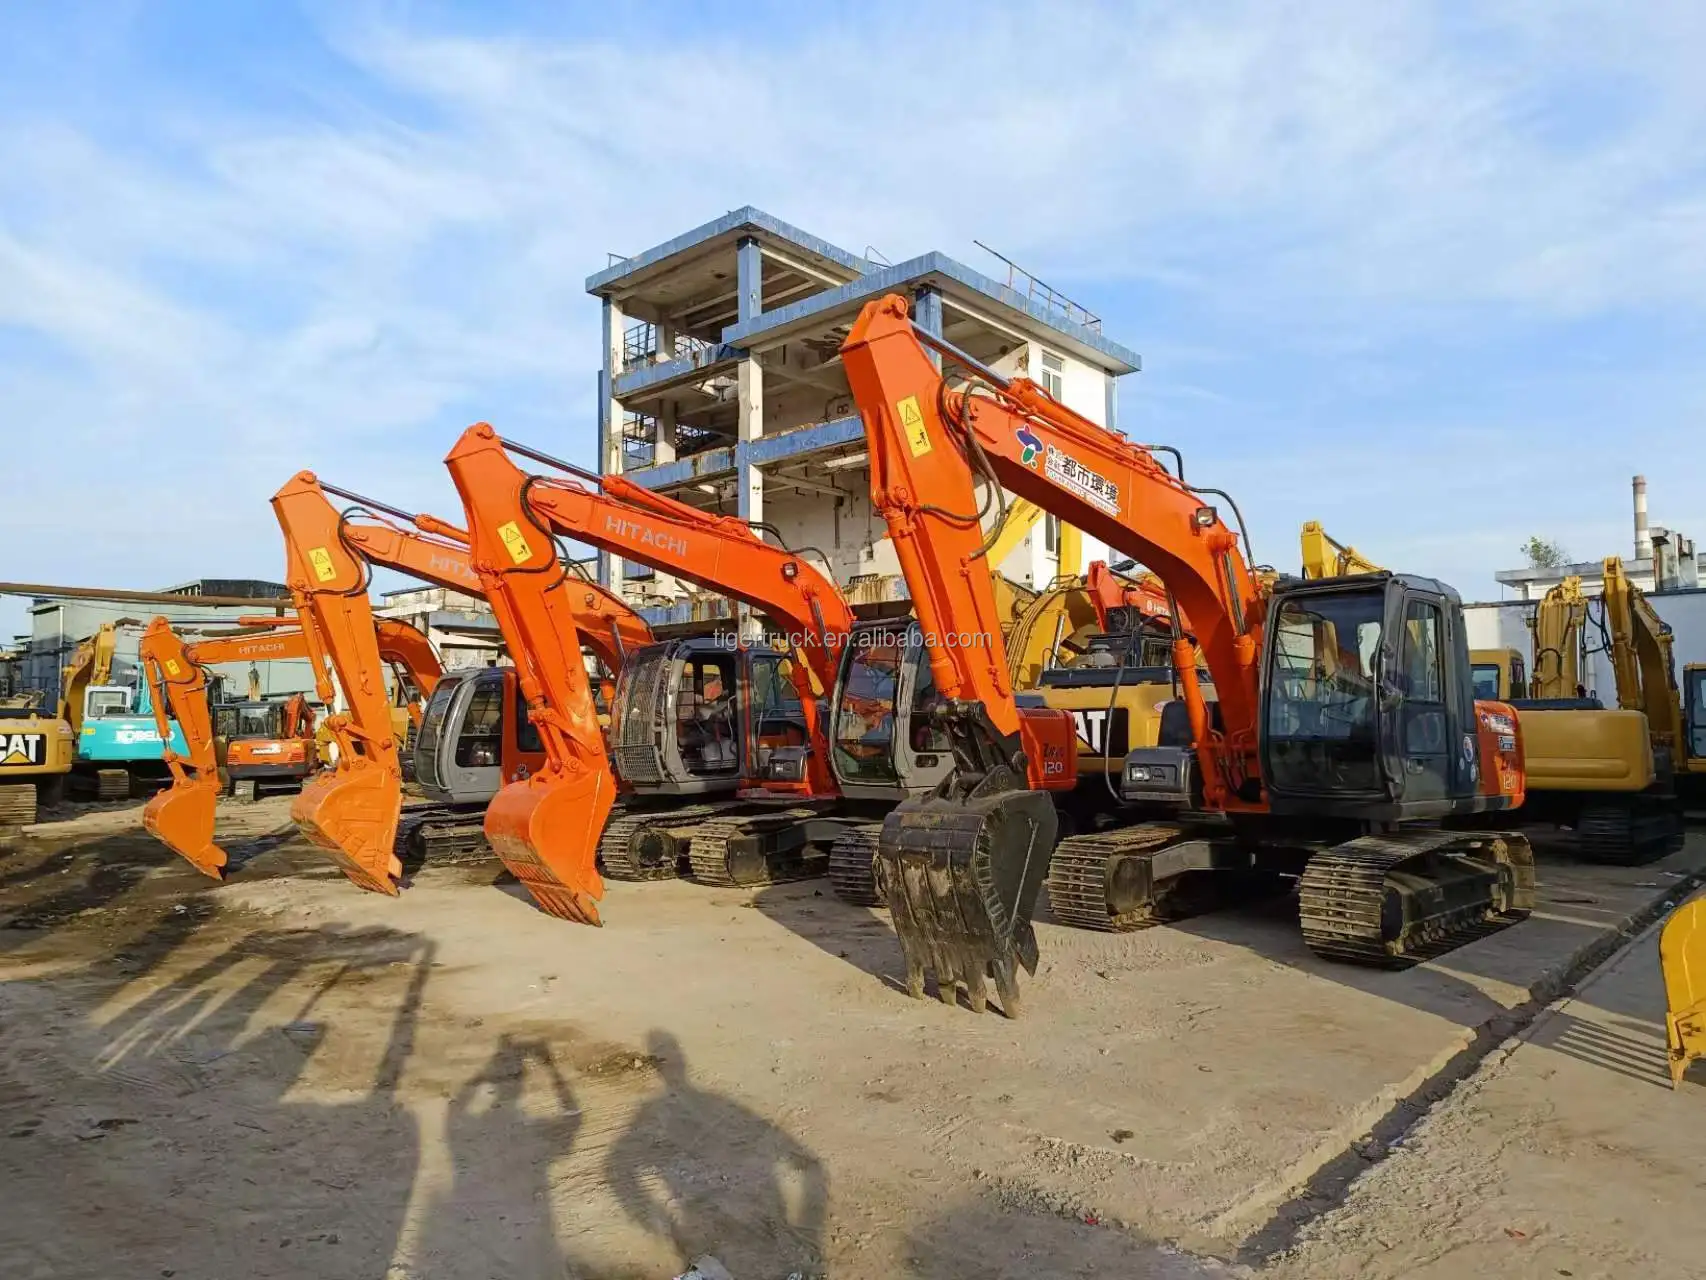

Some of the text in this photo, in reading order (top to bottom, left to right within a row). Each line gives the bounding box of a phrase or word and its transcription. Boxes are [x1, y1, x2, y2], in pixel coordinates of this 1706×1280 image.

[605, 515, 688, 557] HITACHI
[239, 643, 284, 654] HITACHI
[1073, 710, 1106, 754] AT
[1044, 761, 1063, 774] 120
[1503, 773, 1517, 790] 120
